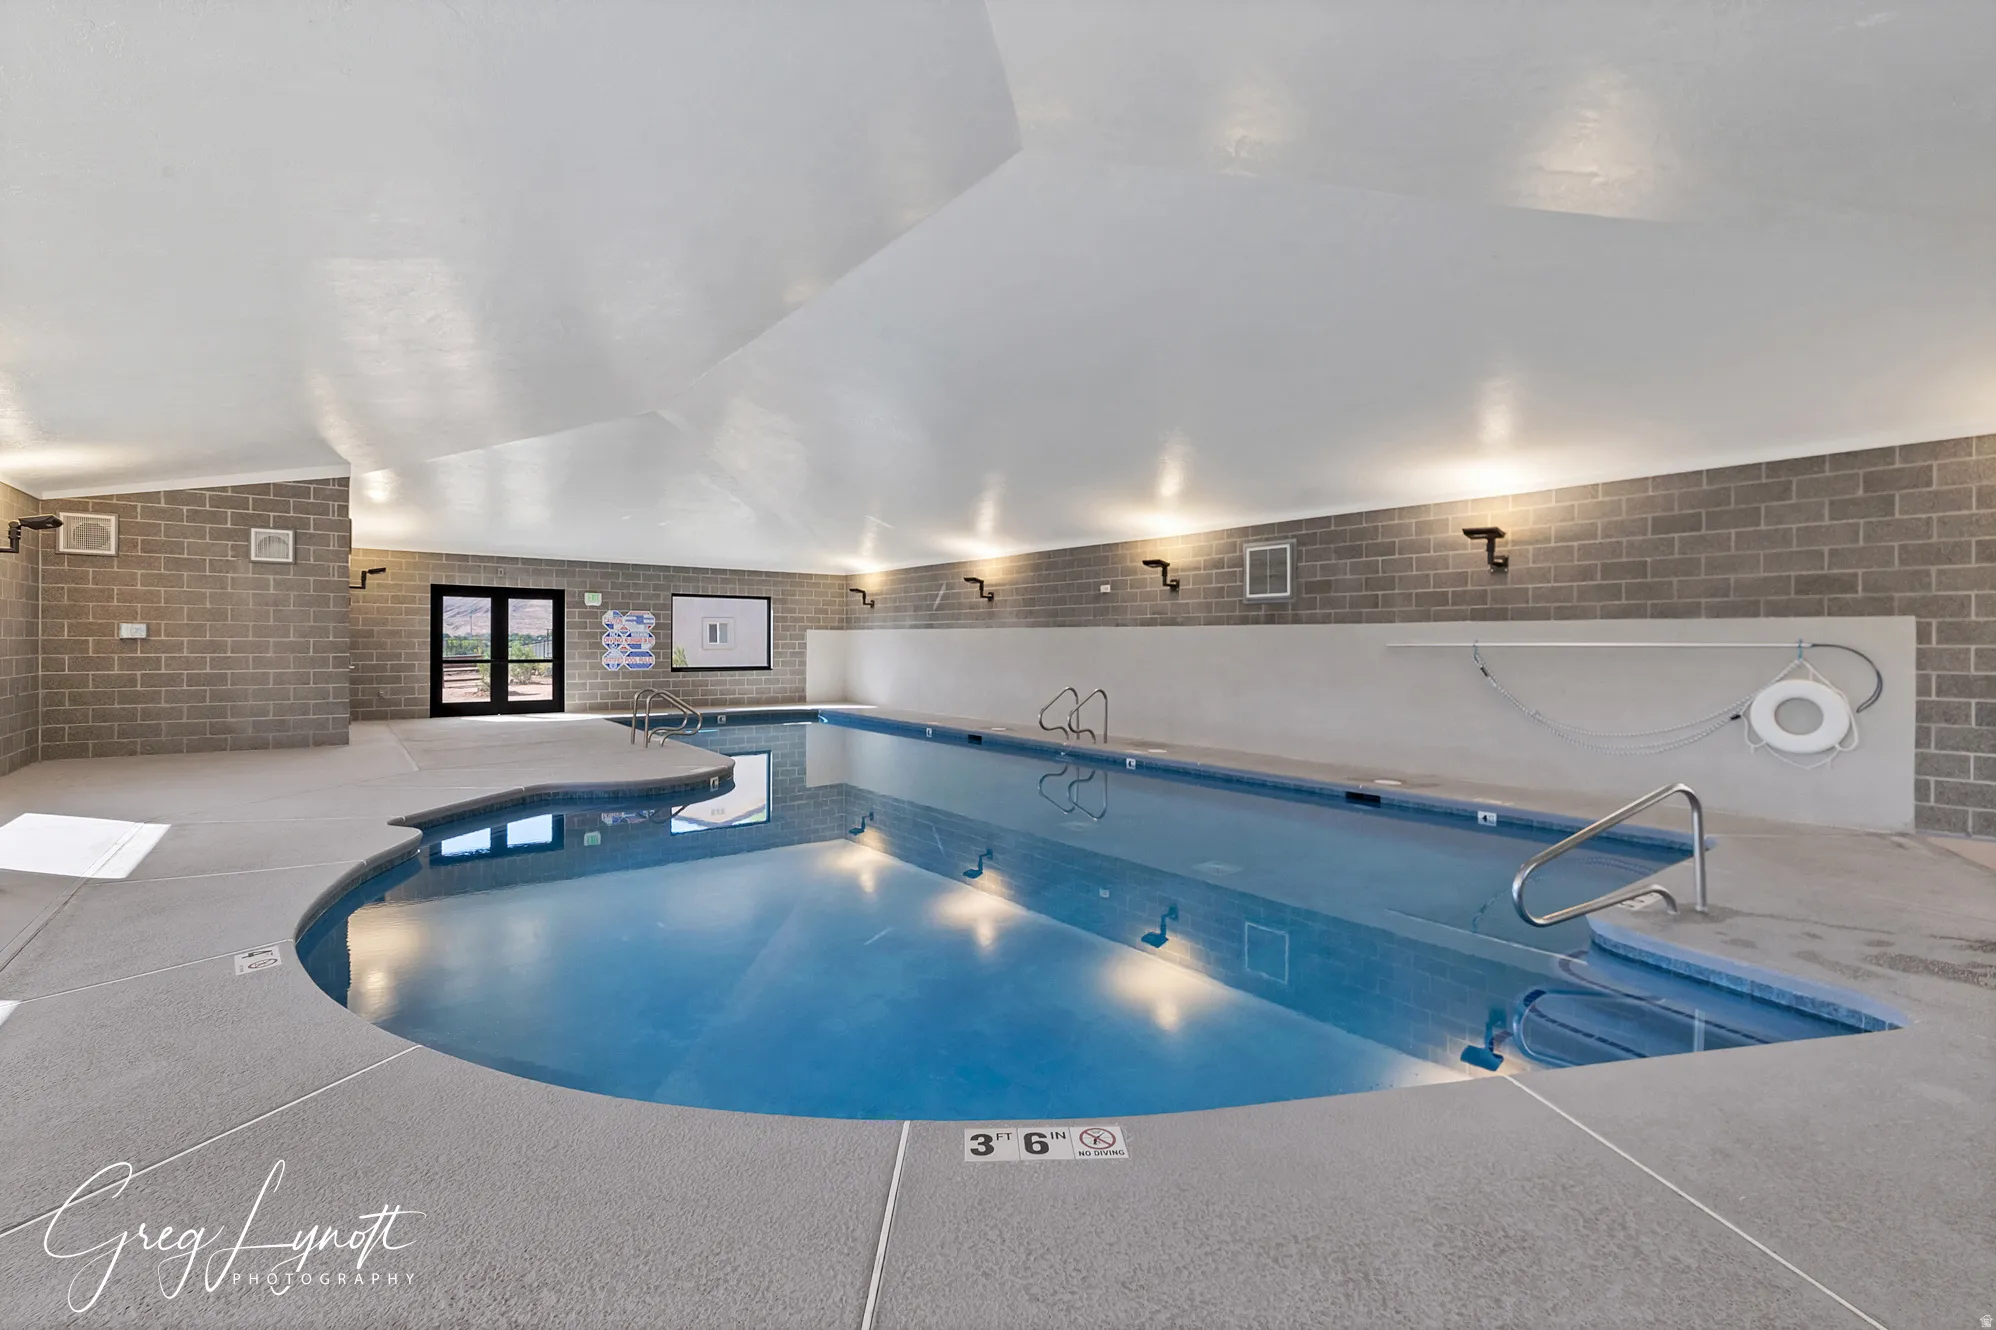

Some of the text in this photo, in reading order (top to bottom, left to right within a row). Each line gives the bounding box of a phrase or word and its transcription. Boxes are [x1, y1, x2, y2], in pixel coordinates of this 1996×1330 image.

[969, 1131, 1066, 1156] 3 FT 6 IN
